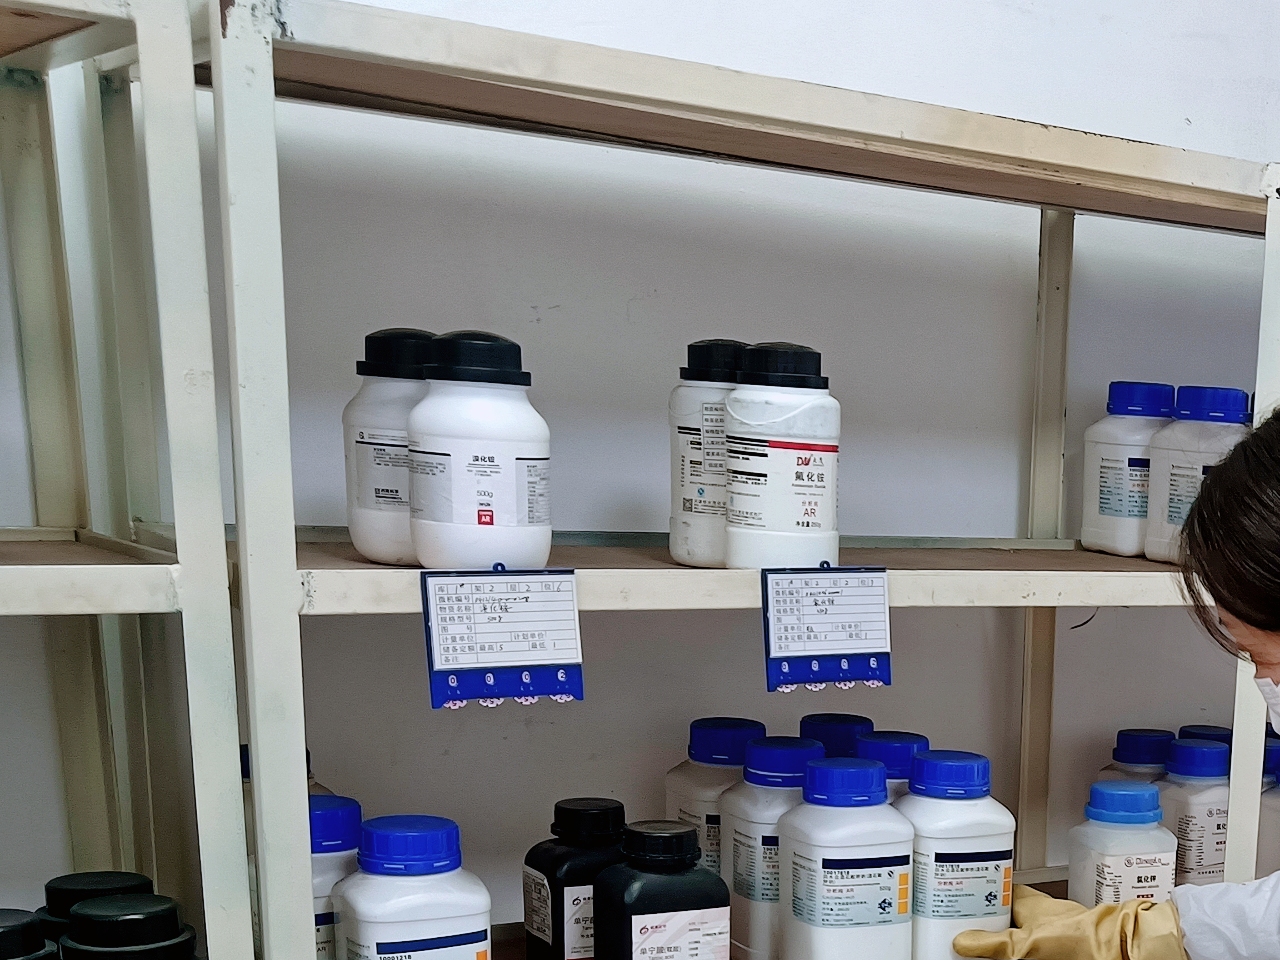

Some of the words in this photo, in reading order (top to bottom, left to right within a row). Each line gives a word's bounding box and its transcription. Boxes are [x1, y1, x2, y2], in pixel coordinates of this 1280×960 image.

[477, 490, 493, 498] 500g
[803, 508, 816, 517] AR
[442, 635, 474, 643] 计量单位
[513, 632, 544, 640] 计划单价
